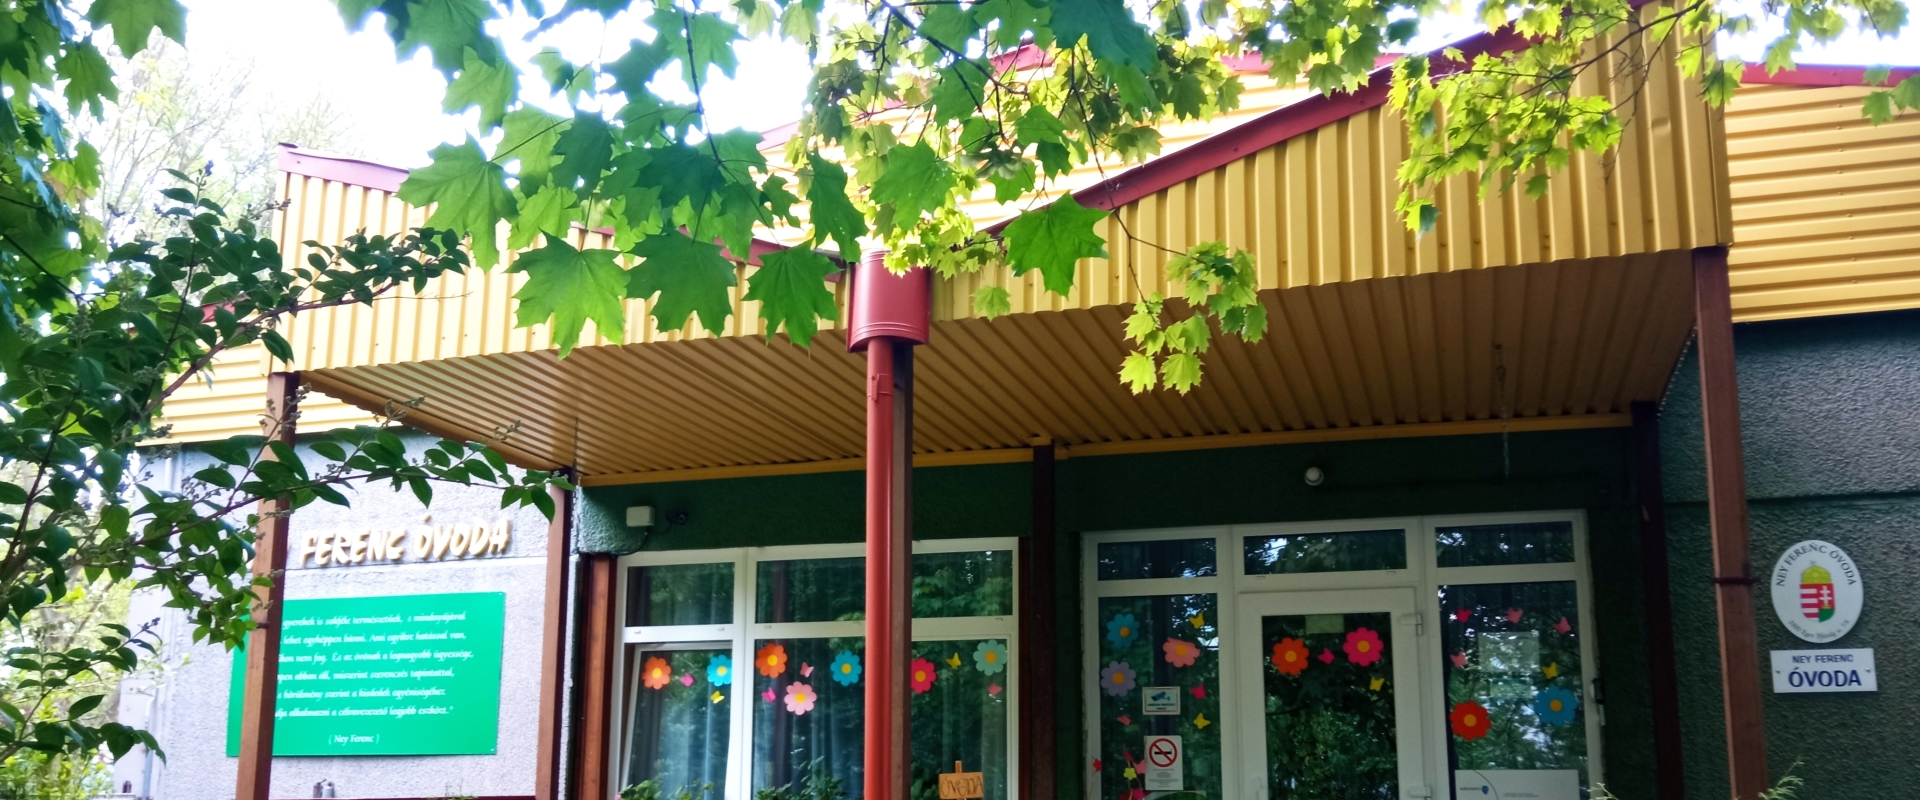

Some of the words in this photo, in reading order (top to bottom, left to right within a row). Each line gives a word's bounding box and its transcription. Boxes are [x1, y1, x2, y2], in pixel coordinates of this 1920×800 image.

[301, 529, 405, 567] FERENC
[413, 514, 511, 561] ÓVODA
[1776, 565, 1789, 587] NEY
[1783, 544, 1828, 566] FERENC
[1829, 549, 1857, 586] ÓVODA
[1792, 655, 1812, 664] NEY
[1815, 654, 1854, 663] FERENC
[1788, 667, 1862, 688] ÓVODA
